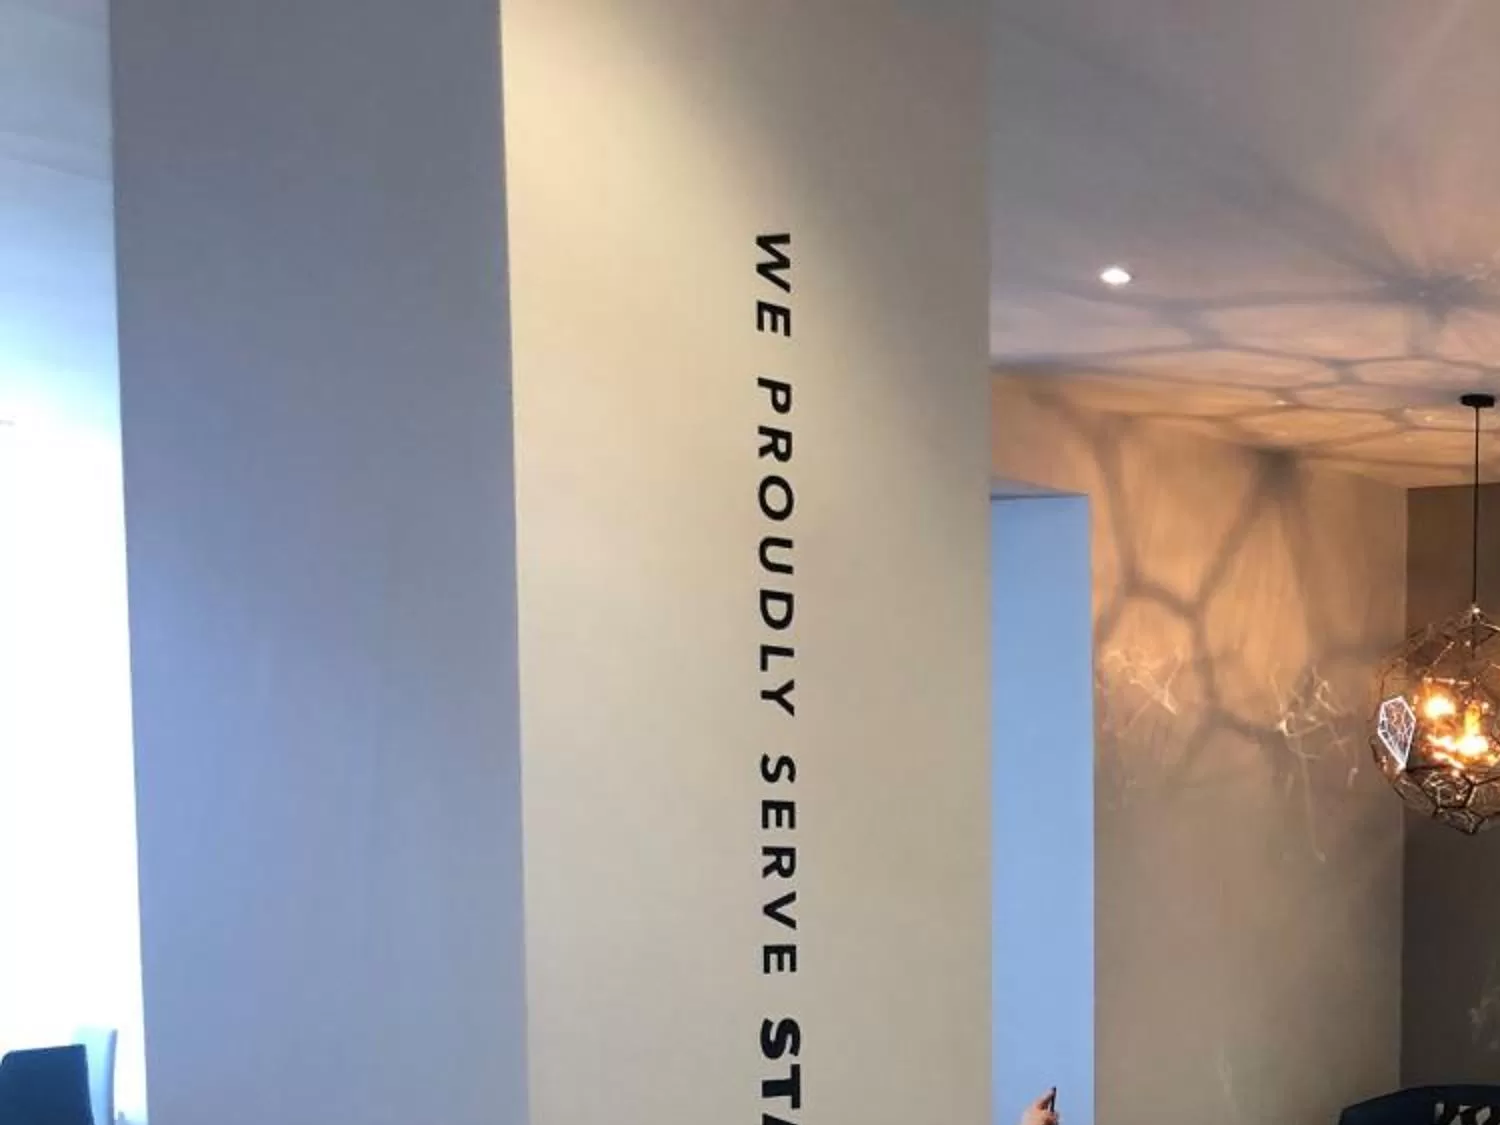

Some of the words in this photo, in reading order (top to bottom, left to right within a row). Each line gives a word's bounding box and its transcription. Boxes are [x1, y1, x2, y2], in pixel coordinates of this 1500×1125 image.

[756, 233, 790, 336] WE
[757, 377, 794, 715] PROUDLY
[760, 754, 796, 973] SERVE
